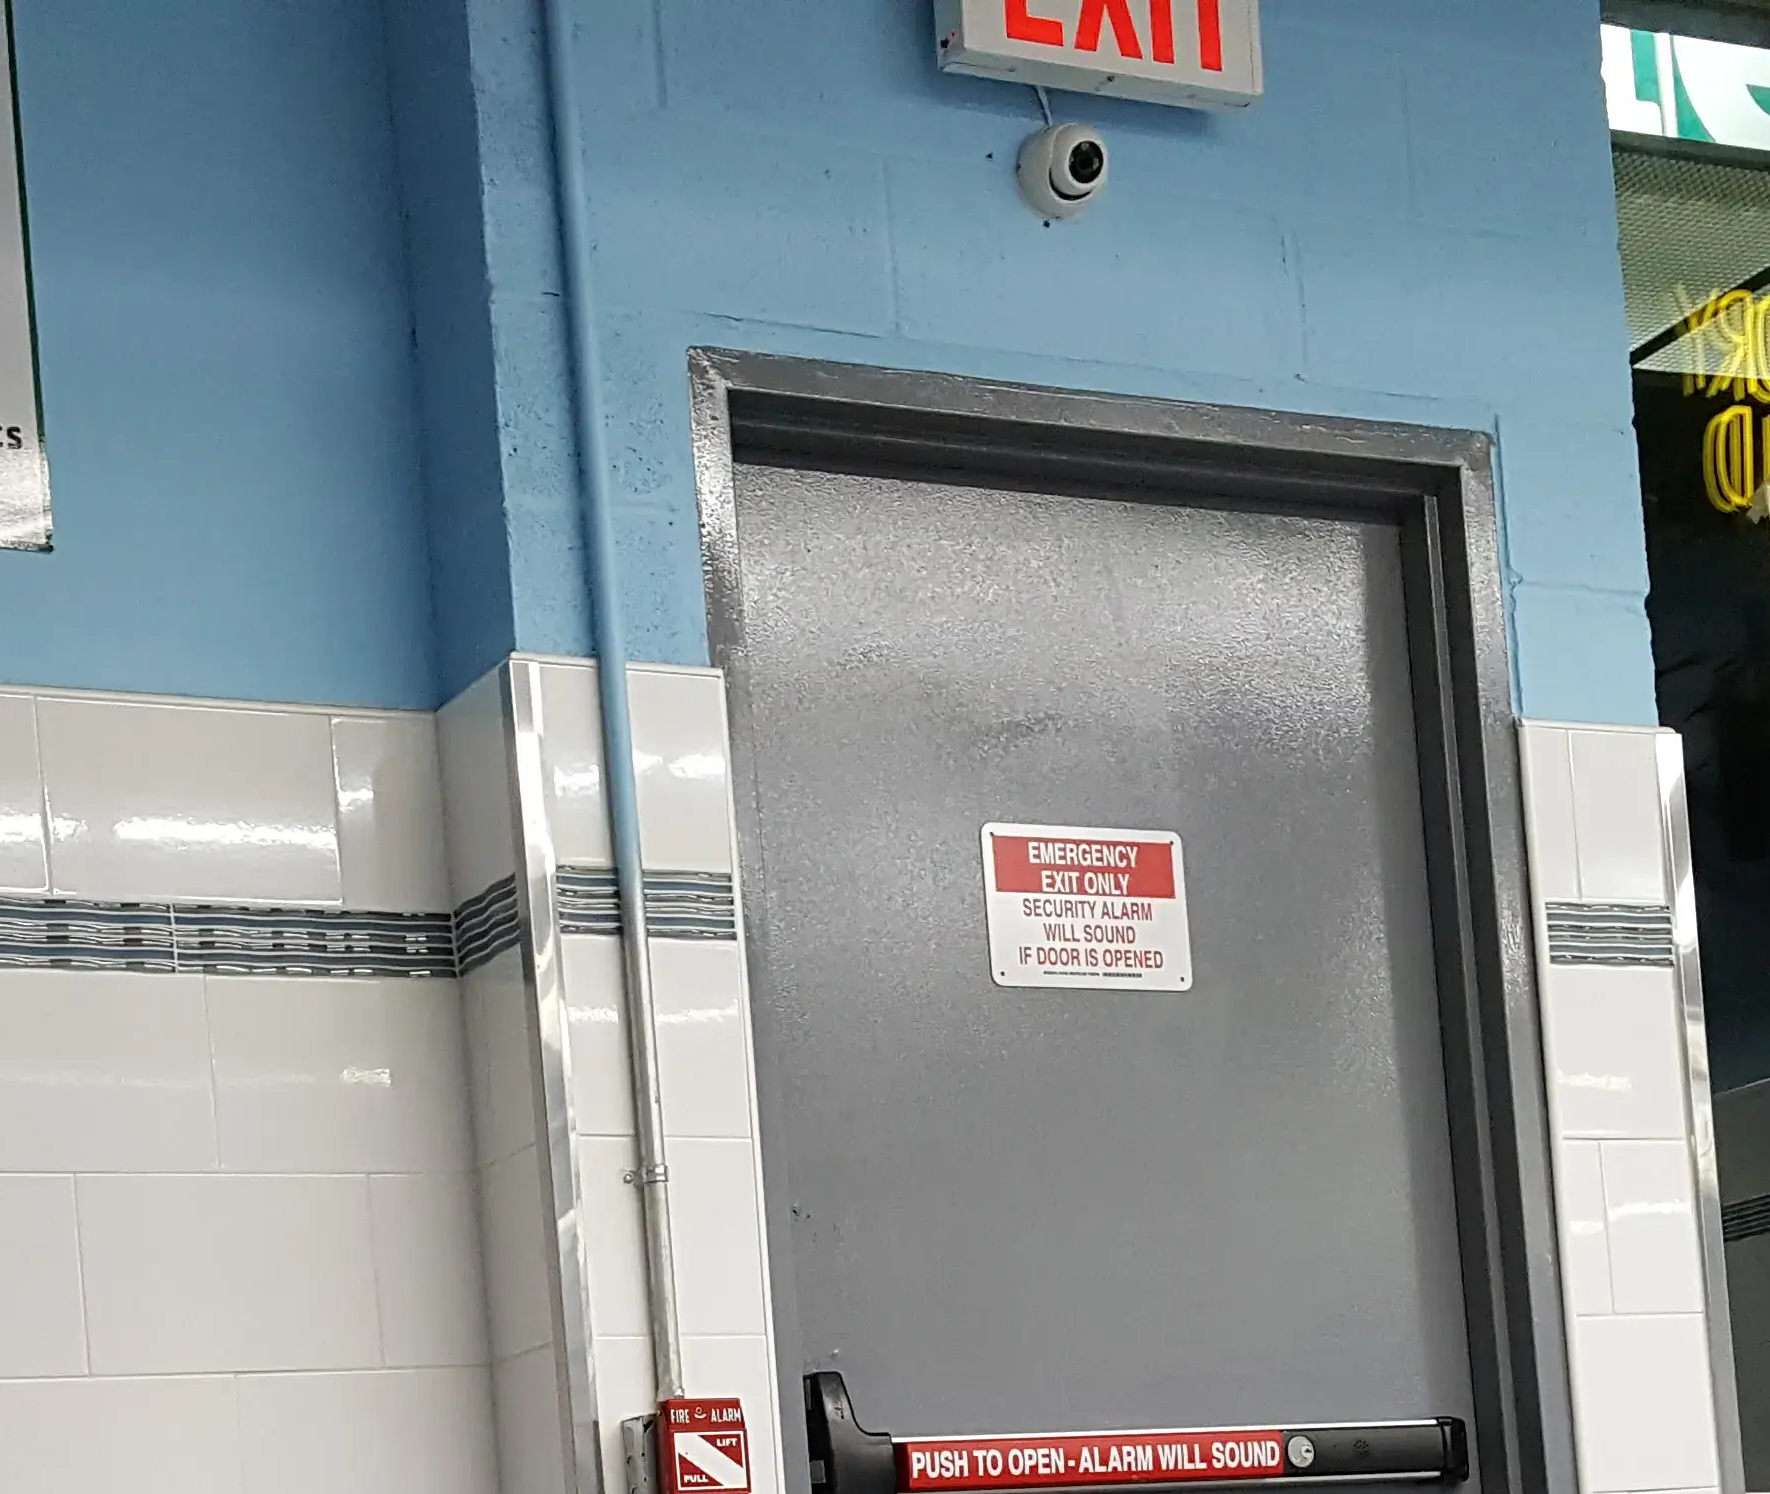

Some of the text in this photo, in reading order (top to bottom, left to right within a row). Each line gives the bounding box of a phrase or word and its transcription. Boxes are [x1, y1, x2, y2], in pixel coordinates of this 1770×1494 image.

[1028, 841, 1139, 867] EMERGENCY
[1041, 871, 1130, 895] EXIT ONLY
[1023, 898, 1153, 921] SECURITY ALARM
[1043, 923, 1136, 944] WILL SOUND
[1019, 946, 1163, 968] IF DOOR IS OPENED
[671, 1408, 741, 1423] FIRE ALARM
[716, 1438, 737, 1446] LIFT
[911, 1450, 968, 1478] PUSH
[973, 1449, 1003, 1476] TO
[1008, 1447, 1065, 1475] OPEN
[1079, 1445, 1153, 1473] ALARM
[1157, 1443, 1207, 1470] WILL
[1211, 1441, 1280, 1468] SOUND
[684, 1475, 709, 1483] PULL
